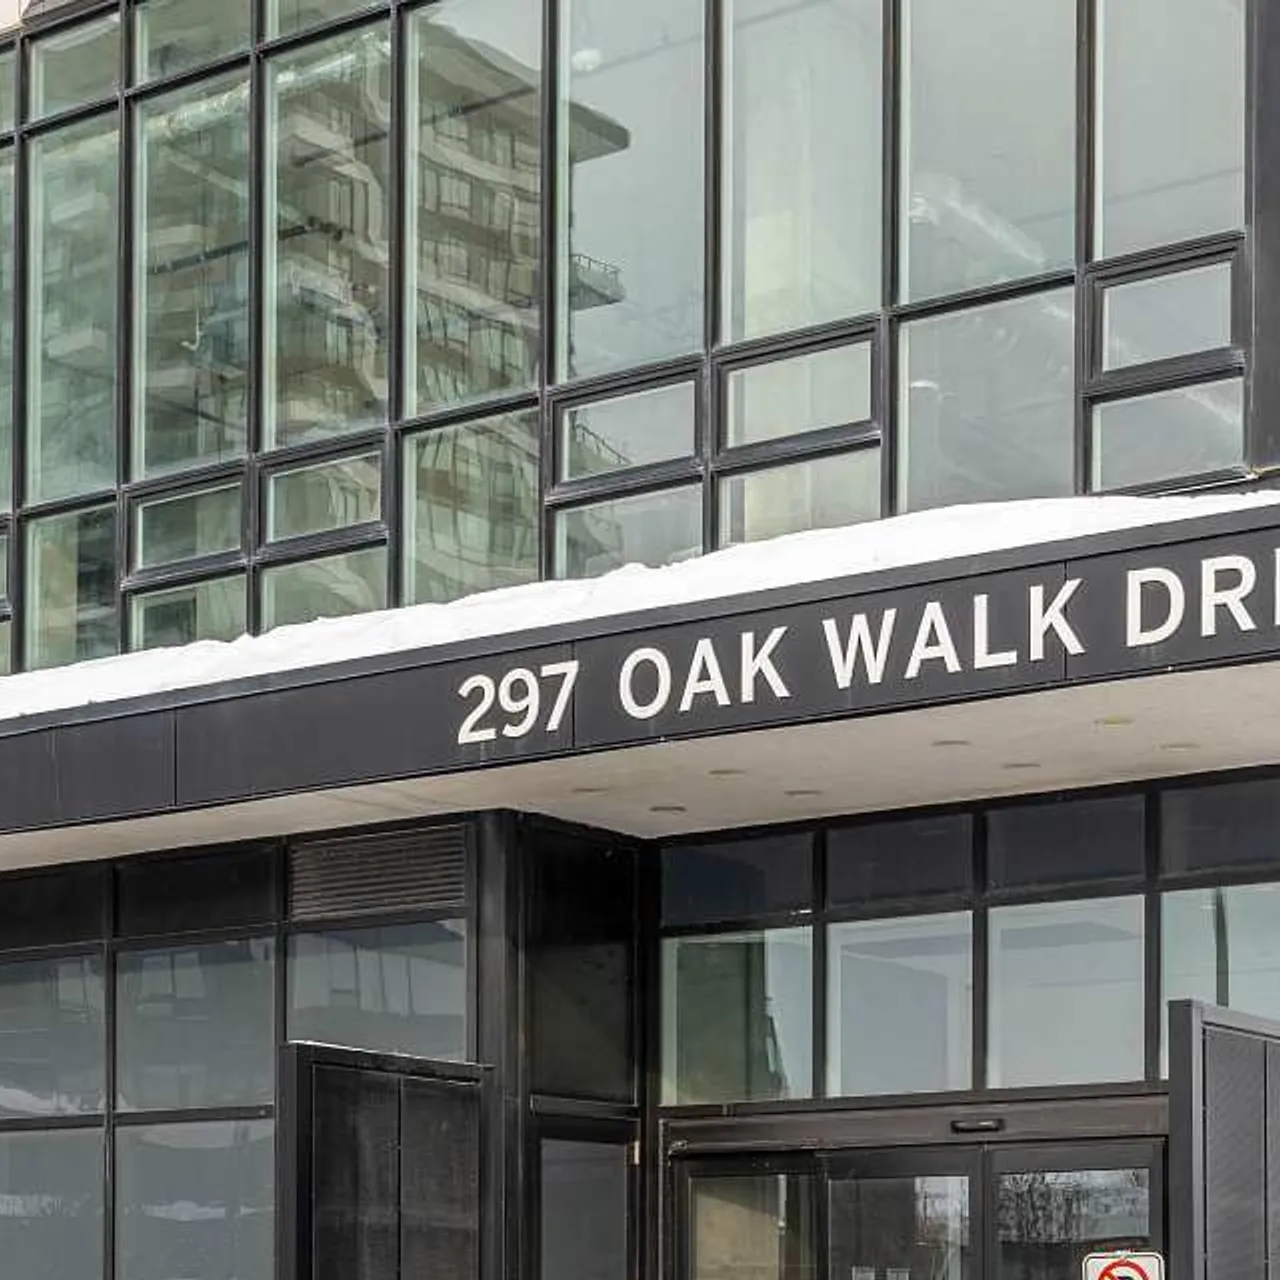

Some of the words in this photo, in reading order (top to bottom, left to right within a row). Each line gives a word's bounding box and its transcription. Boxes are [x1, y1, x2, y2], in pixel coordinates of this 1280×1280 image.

[457, 660, 579, 745] 297
[618, 626, 792, 720] OAK
[822, 577, 1086, 689] WALK
